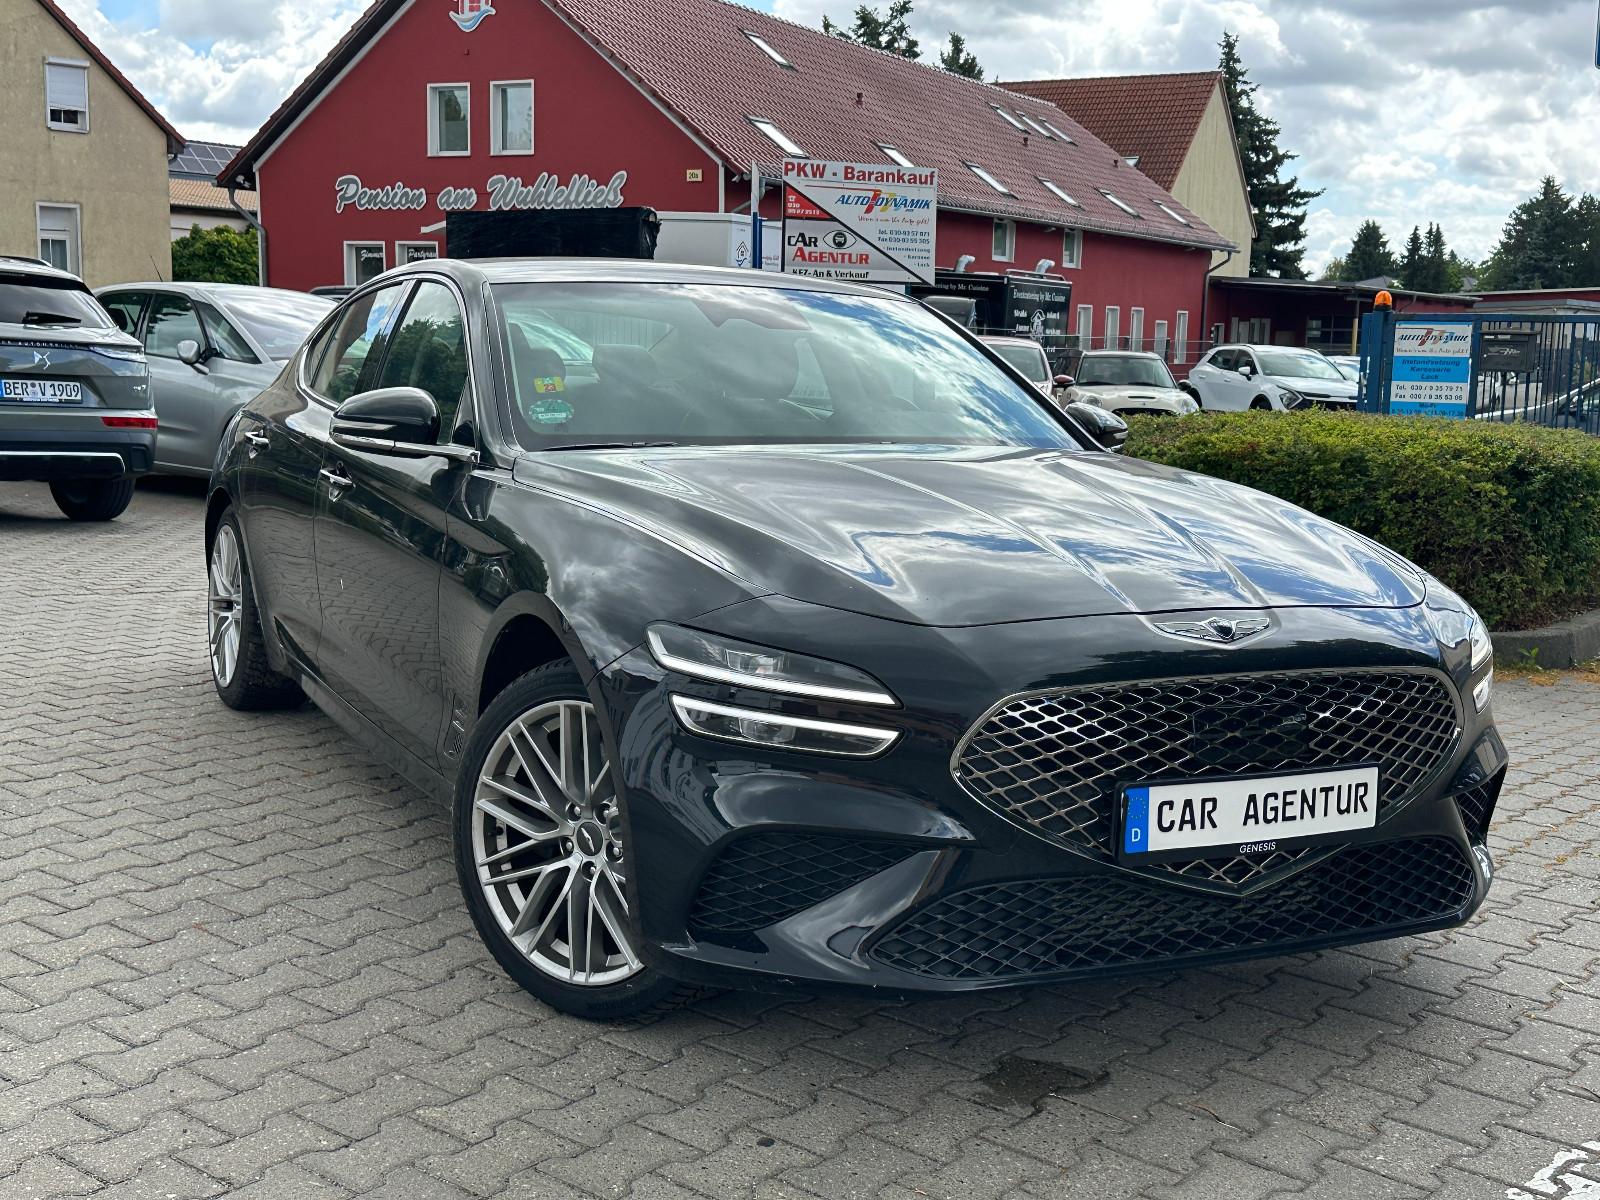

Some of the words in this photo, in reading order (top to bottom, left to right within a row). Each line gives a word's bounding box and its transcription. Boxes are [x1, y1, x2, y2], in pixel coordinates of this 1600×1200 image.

[784, 162, 827, 178] PKW
[843, 166, 935, 185] Barankauf
[335, 174, 426, 213] Pension
[437, 186, 477, 211] am
[487, 170, 627, 211] Wuhlefließ
[787, 232, 818, 248] CAR
[792, 246, 870, 265] AGENTUR
[834, 270, 870, 279] Verkauf
[3, 381, 29, 396] BER
[38, 382, 46, 397] V
[49, 383, 80, 398] 1909
[1157, 797, 1218, 833] CAR
[1242, 782, 1369, 827] AGENTUR
[1131, 828, 1141, 842] D
[1239, 841, 1276, 854] GENESIS
